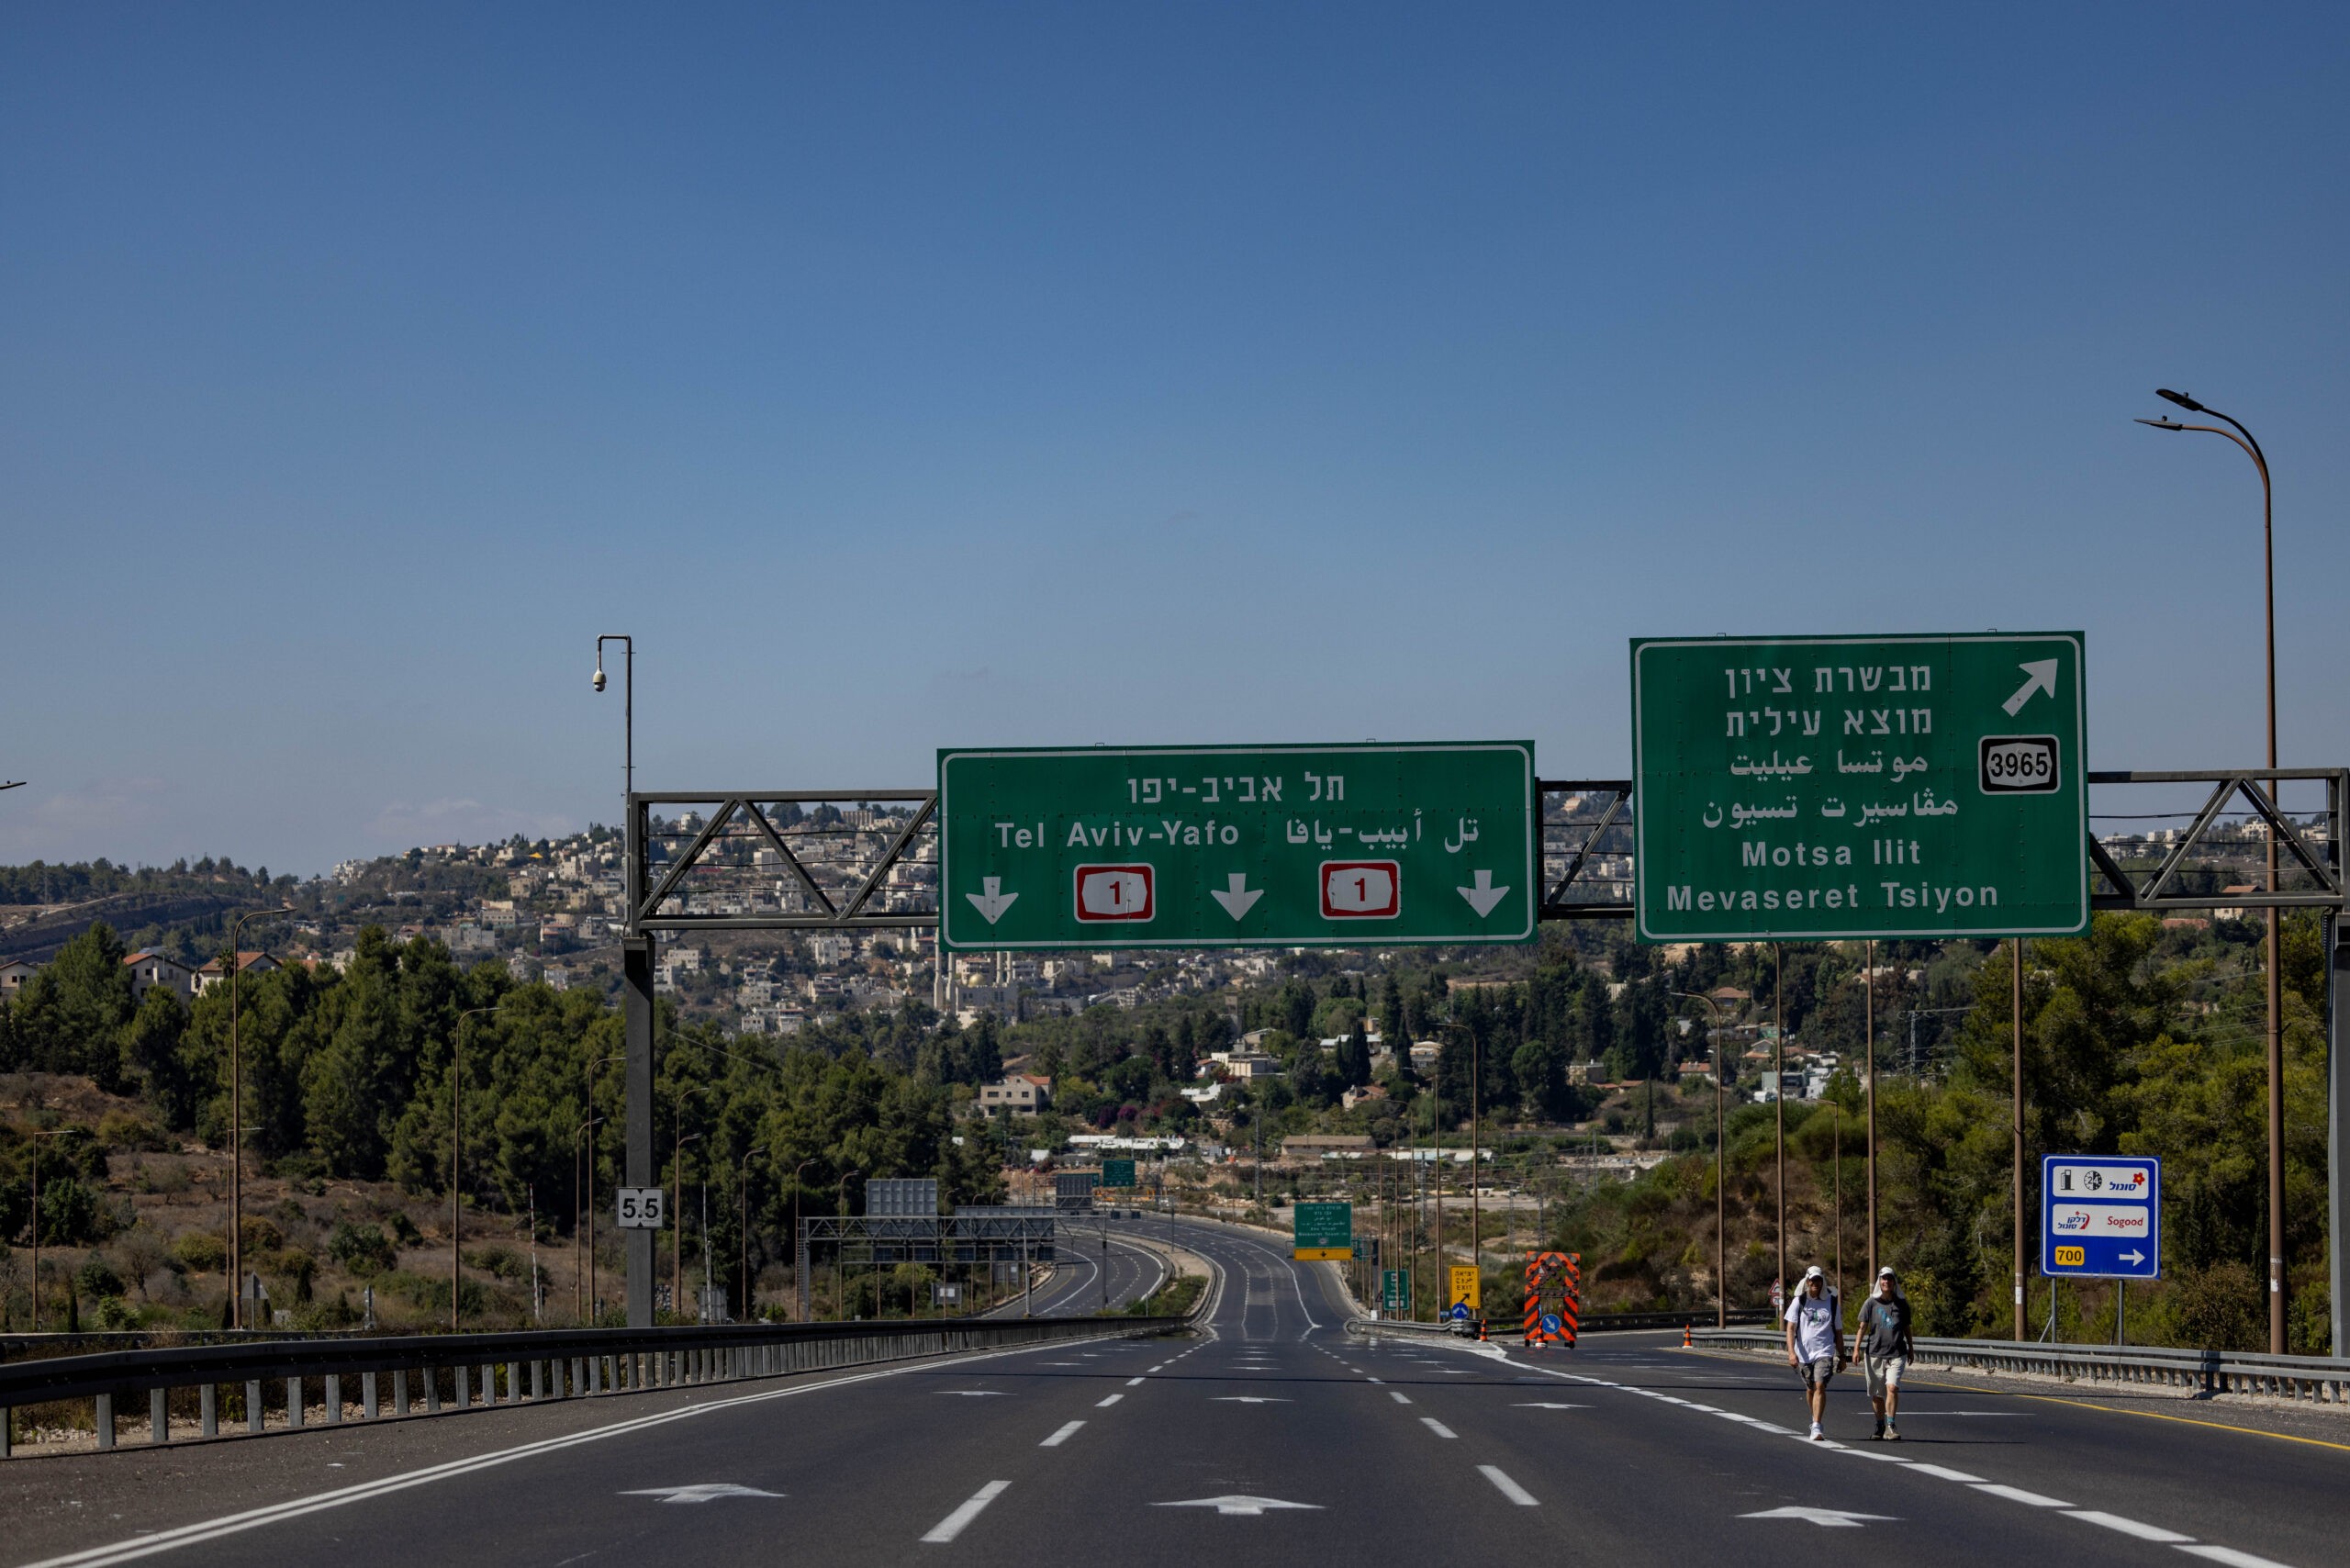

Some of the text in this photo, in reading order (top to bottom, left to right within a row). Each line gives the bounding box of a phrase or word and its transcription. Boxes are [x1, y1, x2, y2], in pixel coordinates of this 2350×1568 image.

[1726, 666, 1930, 698] מבשרת ציון
[1727, 707, 1930, 736] מוצא עילית
[1730, 750, 1928, 782] موتسا عيليت
[1991, 753, 2048, 777] 3965
[1128, 772, 1343, 803] תל אביב-יפו
[1703, 796, 1797, 828] تسيون
[995, 821, 1238, 847] Tel Aviv-Yafo
[1444, 817, 1479, 853] تل
[1743, 840, 1920, 866] Motsa Ilit
[1109, 880, 1120, 904] 1
[1354, 878, 1365, 902] 1
[1668, 882, 1998, 913] Mevaseret Tsiyon
[2087, 1176, 2098, 1185] 24
[2109, 1182, 2137, 1192] סונול
[622, 1198, 658, 1218] 5.5
[2108, 1215, 2143, 1228] Sogood
[2057, 1249, 2082, 1262] 700
